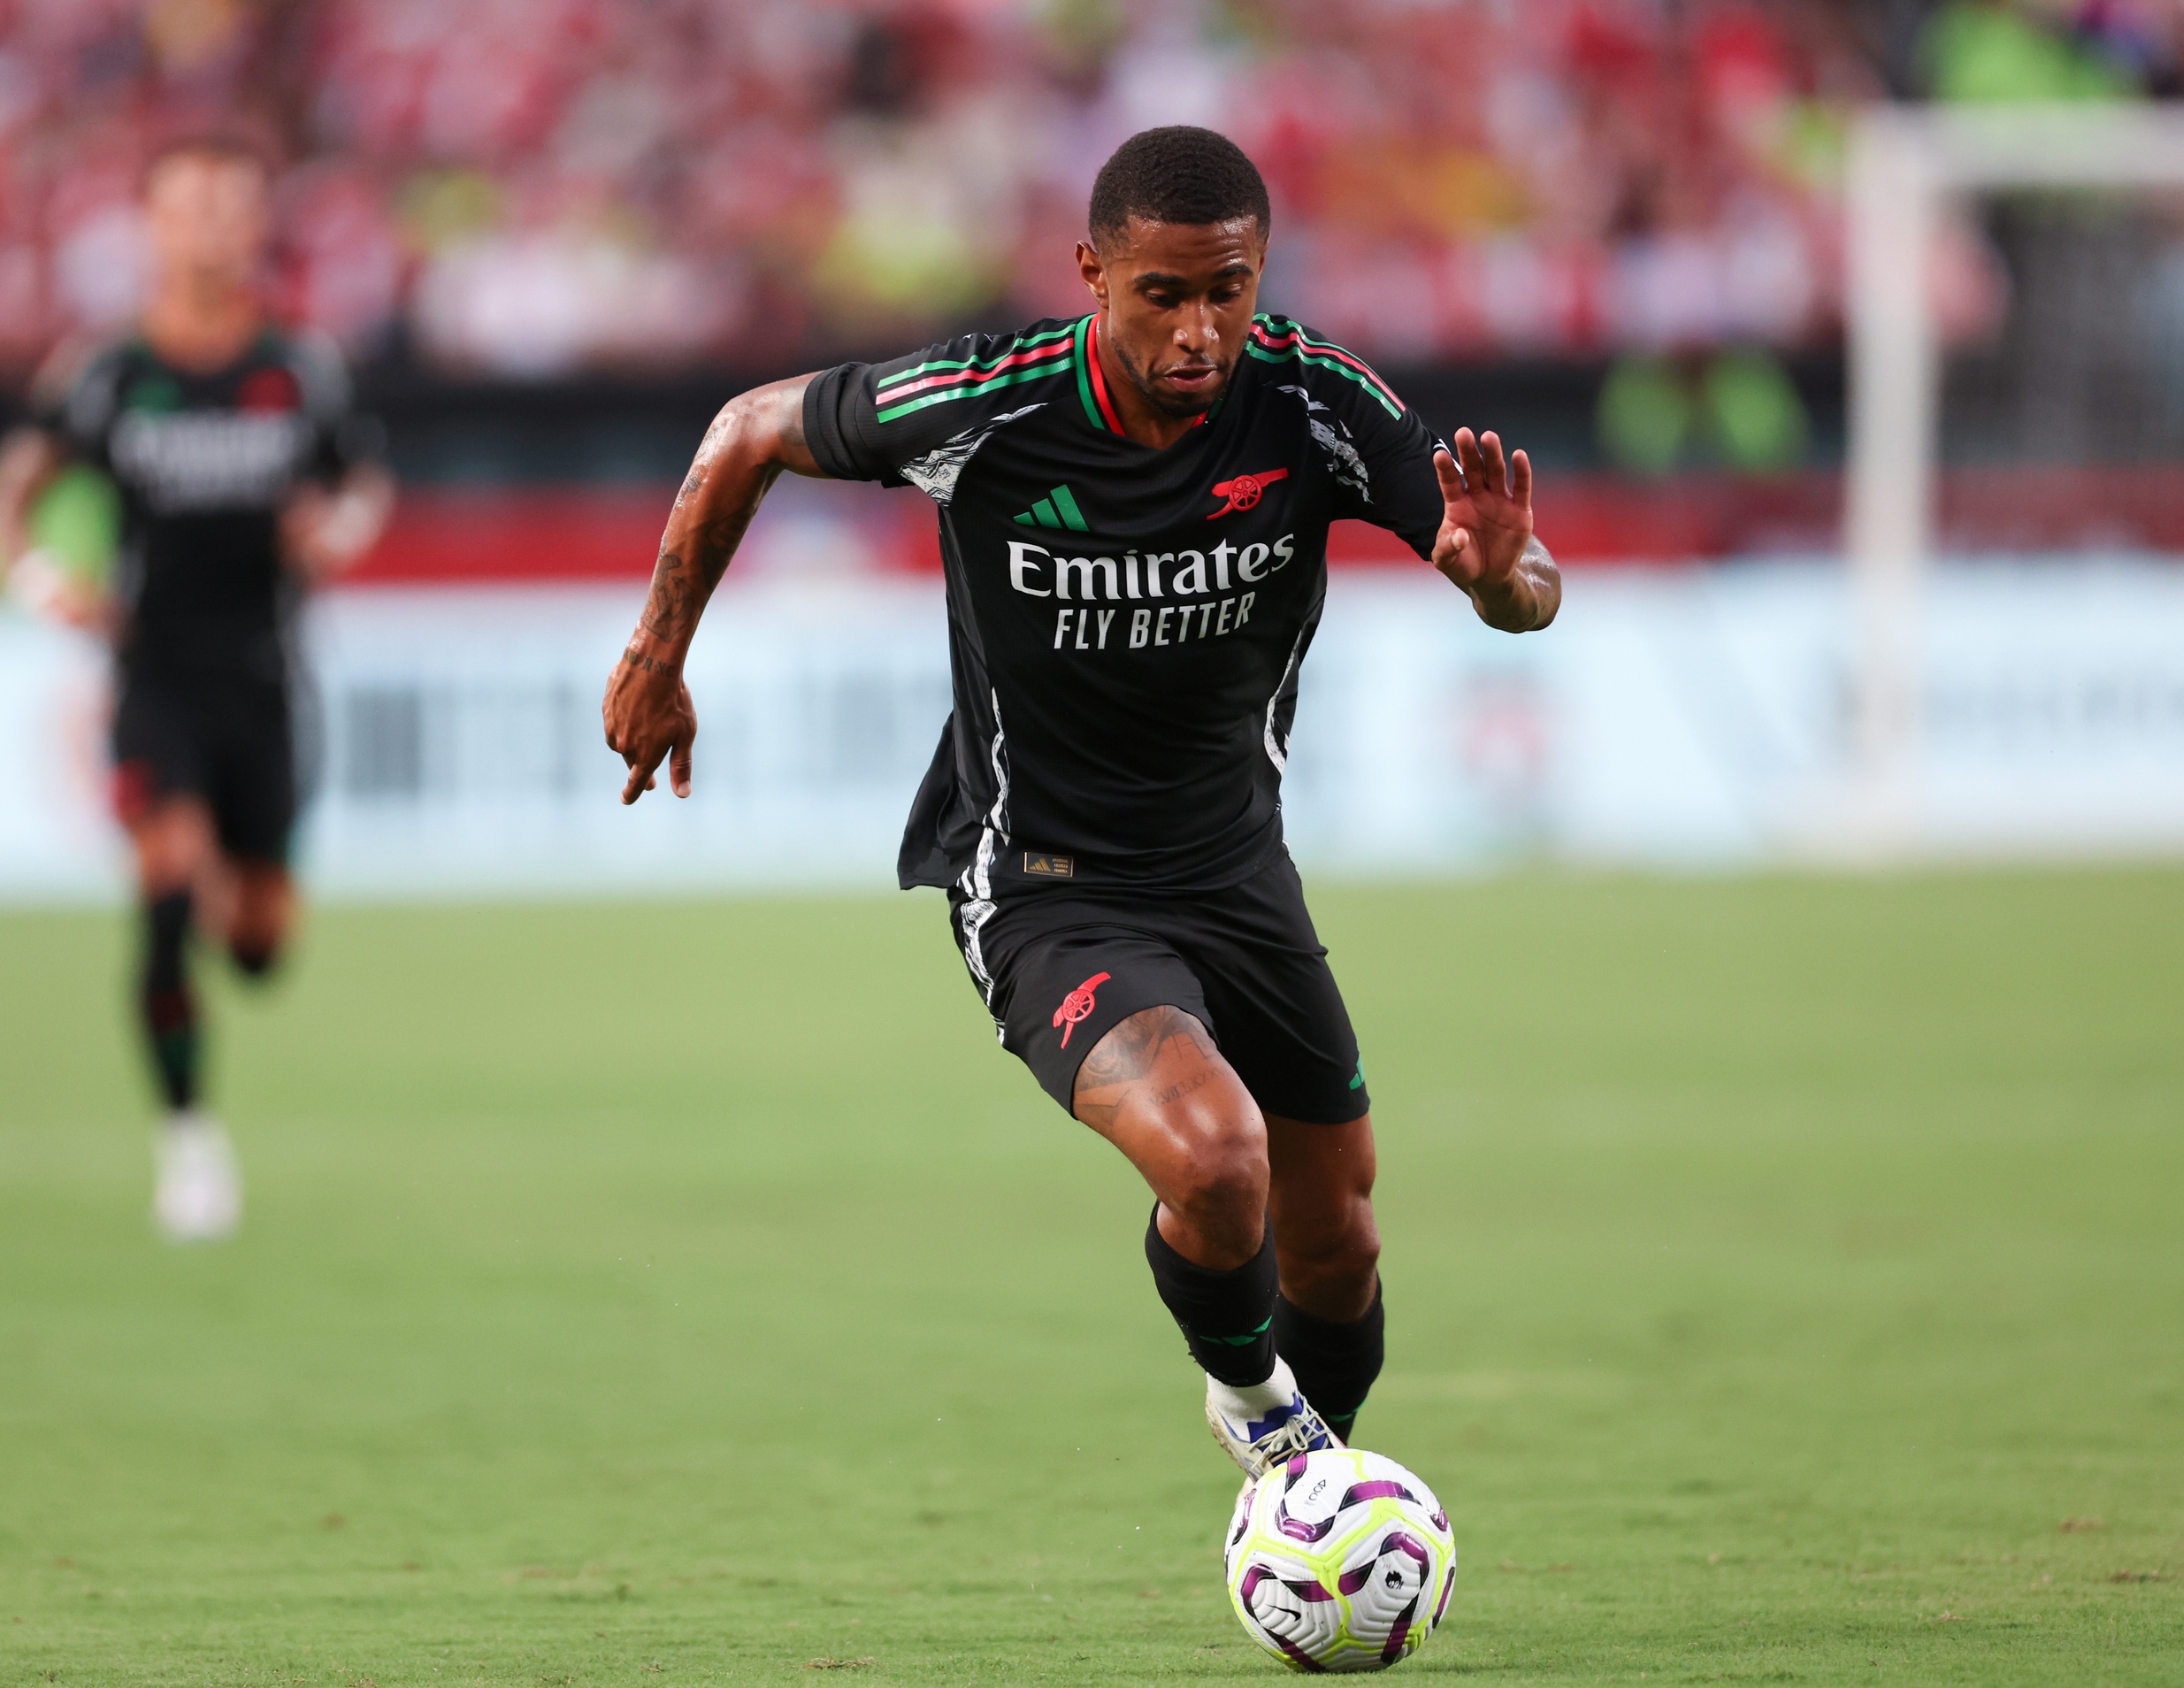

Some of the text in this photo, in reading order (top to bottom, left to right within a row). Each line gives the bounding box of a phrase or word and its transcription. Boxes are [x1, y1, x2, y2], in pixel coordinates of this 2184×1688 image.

[1006, 533, 1295, 601] Emirates
[1053, 591, 1256, 650] FLY BETTER
